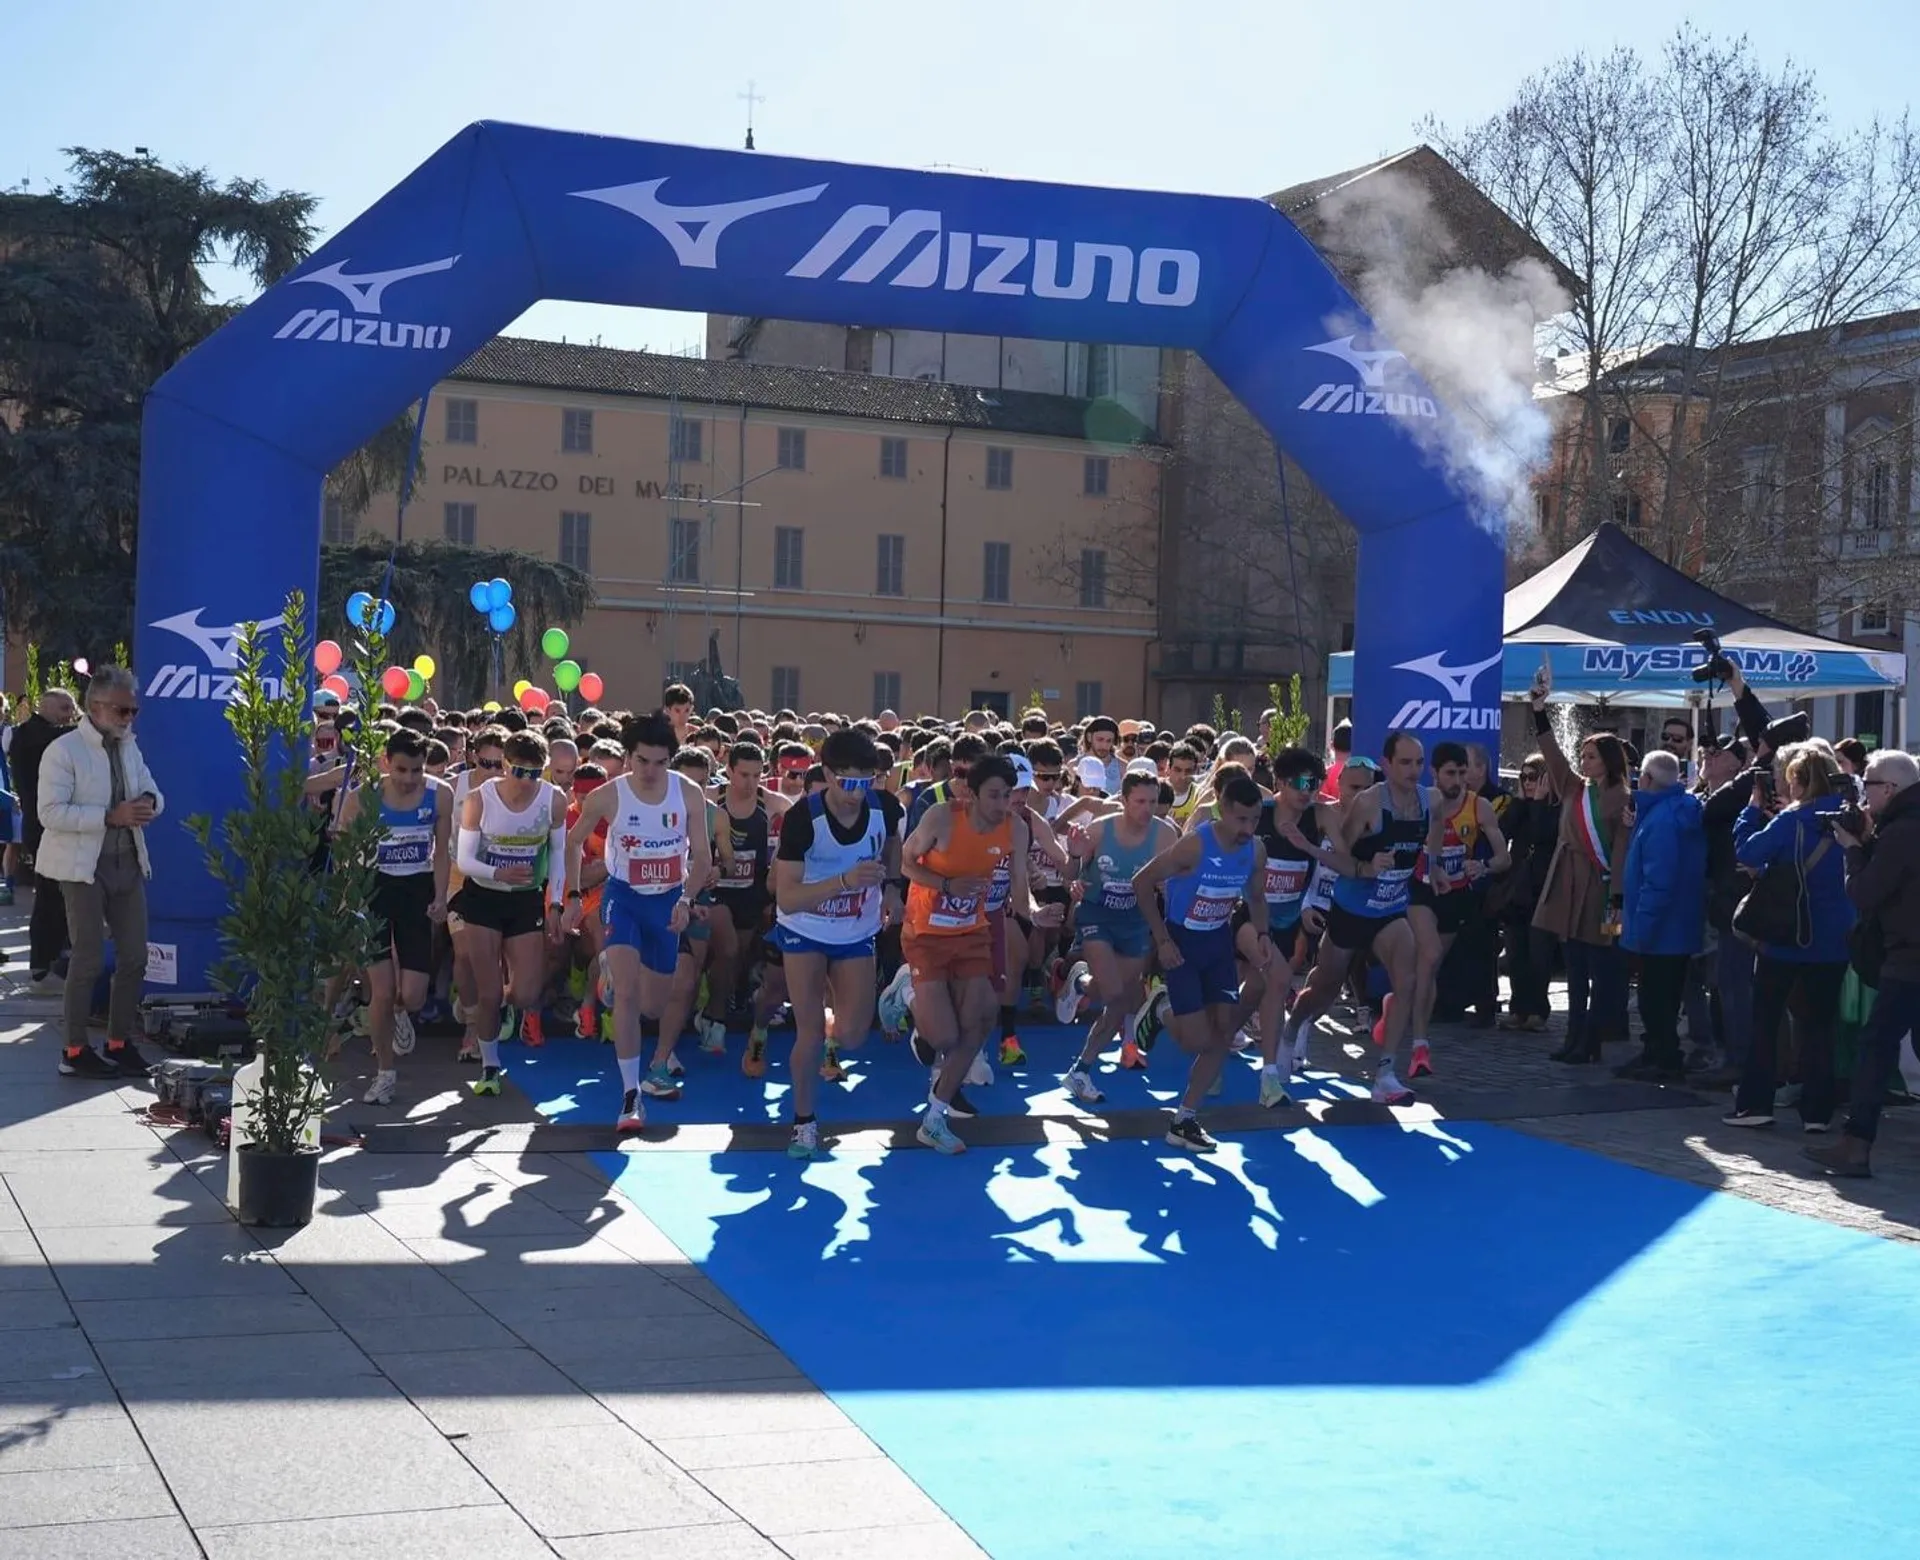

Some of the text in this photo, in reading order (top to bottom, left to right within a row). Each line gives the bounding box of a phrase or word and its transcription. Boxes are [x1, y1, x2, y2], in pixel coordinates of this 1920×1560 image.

[785, 204, 1200, 307] MIZUNO
[273, 309, 451, 349] MIZUNO
[1298, 383, 1437, 417] MIZUNO
[443, 465, 558, 492] PALAZZO
[578, 475, 615, 496] DEI
[1609, 609, 1715, 627] ENDU
[145, 665, 301, 702] MIZN
[641, 863, 670, 880] GALLO
[1265, 873, 1295, 889] FARINA
